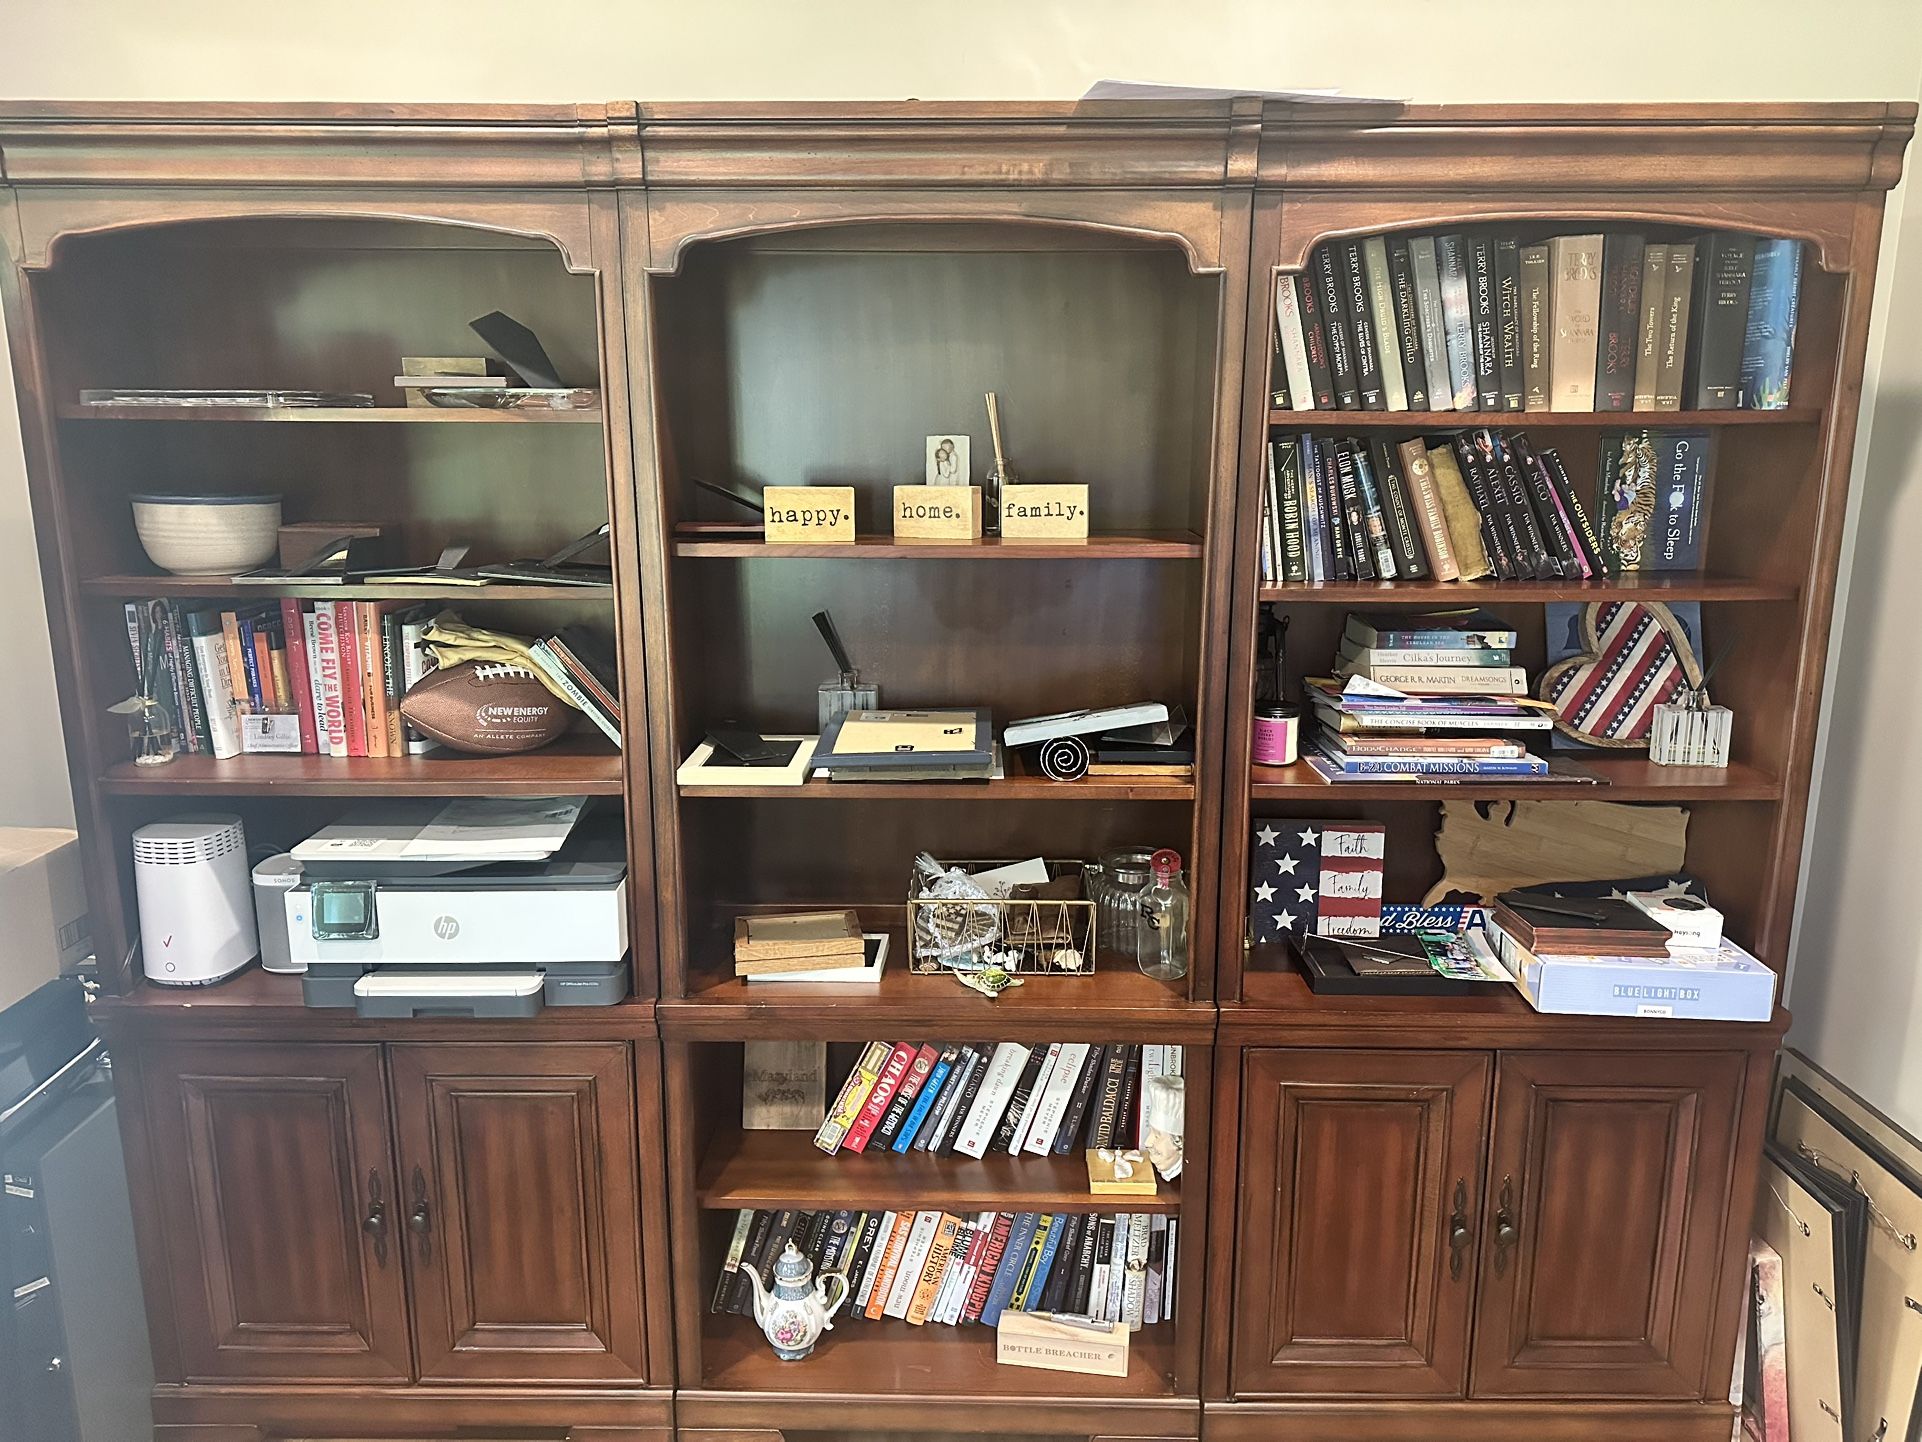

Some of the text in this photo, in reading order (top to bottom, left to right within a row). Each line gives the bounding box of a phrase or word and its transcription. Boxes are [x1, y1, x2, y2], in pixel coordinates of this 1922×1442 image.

[1320, 247, 1337, 313] TERRY BROOKS
[1347, 245, 1364, 312] TERRY BROOKS
[1279, 276, 1294, 317] BROOKS
[1476, 243, 1492, 375] TERRY BROOKS SHANNARA
[1670, 296, 1681, 313] King
[1396, 272, 1416, 363] THE DARKLING CHILD
[1531, 301, 1539, 333] Fellowship
[1644, 306, 1655, 356] The Two Towers
[1669, 313, 1677, 324] the
[1331, 334, 1340, 353] GYPSY
[1455, 320, 1471, 387] TERRY BROOKS
[1605, 332, 1619, 374] BROOKS
[1667, 332, 1676, 354] Return
[1665, 355, 1673, 368] The
[1674, 439, 1689, 460] Go
[1325, 457, 1334, 484] CHARLES
[1337, 451, 1356, 500] ELON MUSK
[1672, 462, 1687, 481] the
[901, 502, 961, 519] home.
[1004, 501, 1085, 521] family.
[1328, 485, 1338, 515] BUKOWSKI
[1468, 466, 1503, 554] RAPHAEL EVA WINNERS
[1486, 465, 1521, 554] ALEXEI EVA WINNERS
[1503, 463, 1540, 553] CASSIO EVA WINNERS
[1530, 470, 1569, 553] NICO EVA WINNERS
[1667, 483, 1685, 512] Fk
[769, 506, 850, 527] happy.
[1283, 499, 1299, 558] ROBIN HOOD
[1418, 476, 1449, 559] THE SWISS FAMILY ROBINSON
[1568, 489, 1601, 555] THE OUTSIDERS
[1668, 513, 1678, 525] to
[1335, 539, 1341, 547] ON
[1662, 527, 1681, 560] Sleep
[181, 644, 193, 678] MANAGING
[246, 647, 257, 687] PERFECT PHRASES
[381, 634, 394, 696] LINCOLN THE
[1402, 652, 1472, 664] Cilka's Journey
[187, 677, 198, 707] DIFFICULT
[309, 638, 328, 732] Brown dare to lead
[316, 613, 344, 746] COME FLY THE WORLD
[562, 678, 588, 706] ZOMBIE
[1379, 674, 1507, 684] GEORGE R. R. MARTIN DREAMSONGS
[192, 707, 202, 730] PEOPLE
[1360, 762, 1479, 773] B-24 COMBAT MISSIONS
[1335, 834, 1369, 855] Faith
[1328, 874, 1370, 899] Family
[438, 916, 456, 939] hp
[1322, 917, 1372, 936] Freedom
[1396, 912, 1455, 928] Bless
[1614, 986, 1699, 999] BLUE LIGHT BOX
[869, 1048, 910, 1107] CHAOS
[907, 1072, 921, 1084] THE
[997, 1049, 1017, 1077] breaking
[1055, 1050, 1079, 1085] eclipse
[1080, 1045, 1100, 1094] Fifty Shades Darker
[896, 1096, 908, 1106] OF
[899, 1081, 916, 1100] CURSE
[932, 1063, 961, 1116] HELMET PILLOW
[947, 1064, 984, 1138] LUCIANO EVA WINNERS
[1100, 1077, 1119, 1123] BALDACCI
[891, 1102, 905, 1116] THE
[820, 1213, 831, 1233] GOING
[1021, 1210, 1034, 1228] THE
[1068, 1215, 1077, 1228] Fifty
[813, 1232, 824, 1252] CLEAR
[831, 1236, 840, 1245] THE
[956, 1228, 974, 1260] BLUME
[1012, 1226, 1028, 1252] INNER
[1038, 1215, 1063, 1265] Beautiful Boy
[1066, 1227, 1074, 1244] Shades
[1079, 1212, 1097, 1268] SONS ANARCHY
[1130, 1214, 1142, 1256] MELTZER
[1139, 1224, 1149, 1247] BRAD
[849, 1216, 878, 1288] GREY JAMES
[873, 1219, 911, 1307] SAS SURVIVAL HANDBOOK
[923, 1243, 943, 1285] HISTORY
[932, 1247, 949, 1285] AMERICAN
[1003, 1250, 1019, 1277] CIRCLE
[964, 1214, 1009, 1321] AMERICAN KINGPIN
[894, 1268, 913, 1309] new moon
[1125, 1278, 1137, 1317] SHADOW
[1003, 1344, 1101, 1360] BOTTLE BREACHER
